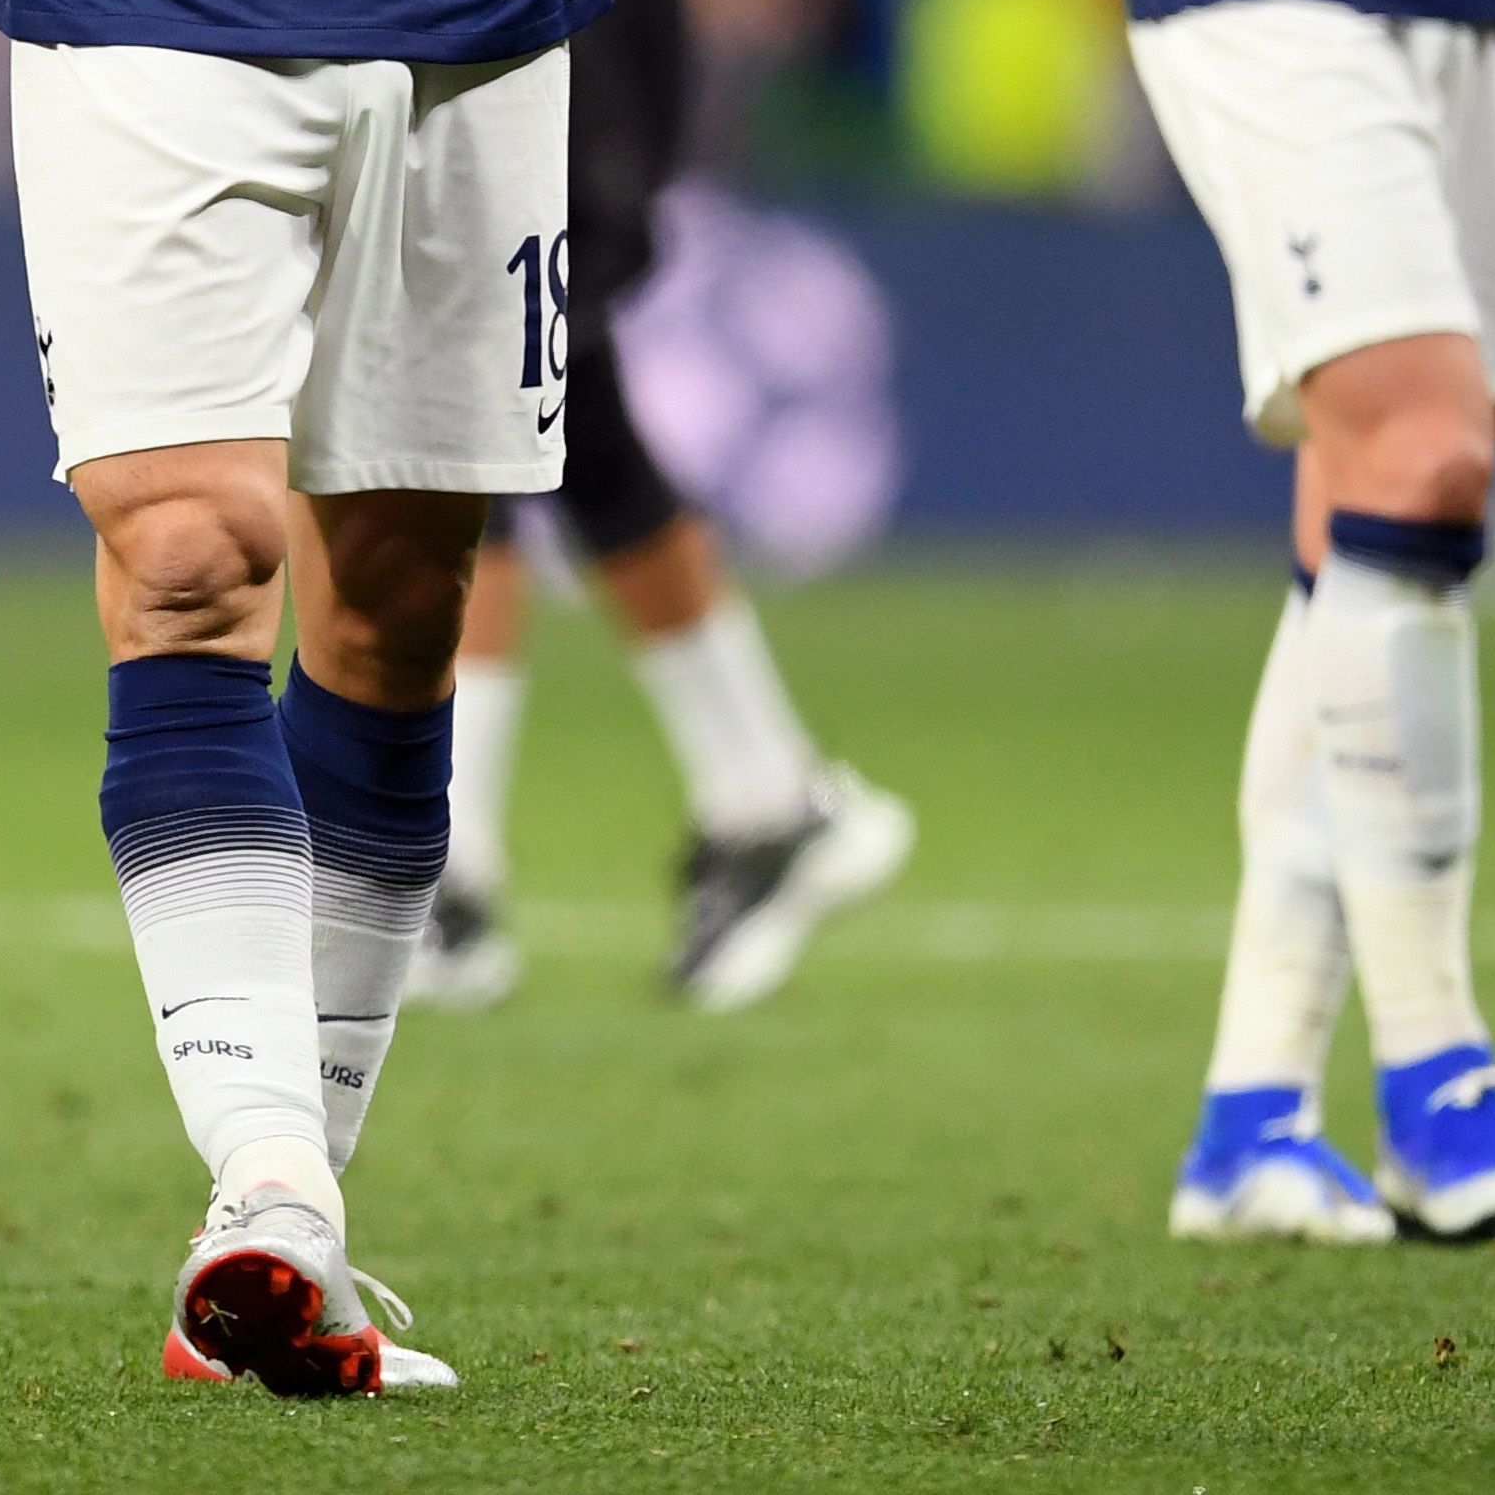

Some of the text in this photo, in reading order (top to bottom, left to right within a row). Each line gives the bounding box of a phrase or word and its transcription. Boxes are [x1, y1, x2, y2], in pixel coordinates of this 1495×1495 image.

[506, 229, 568, 388] 18
[173, 1040, 253, 1061] SPURS
[320, 1061, 365, 1089] URS
